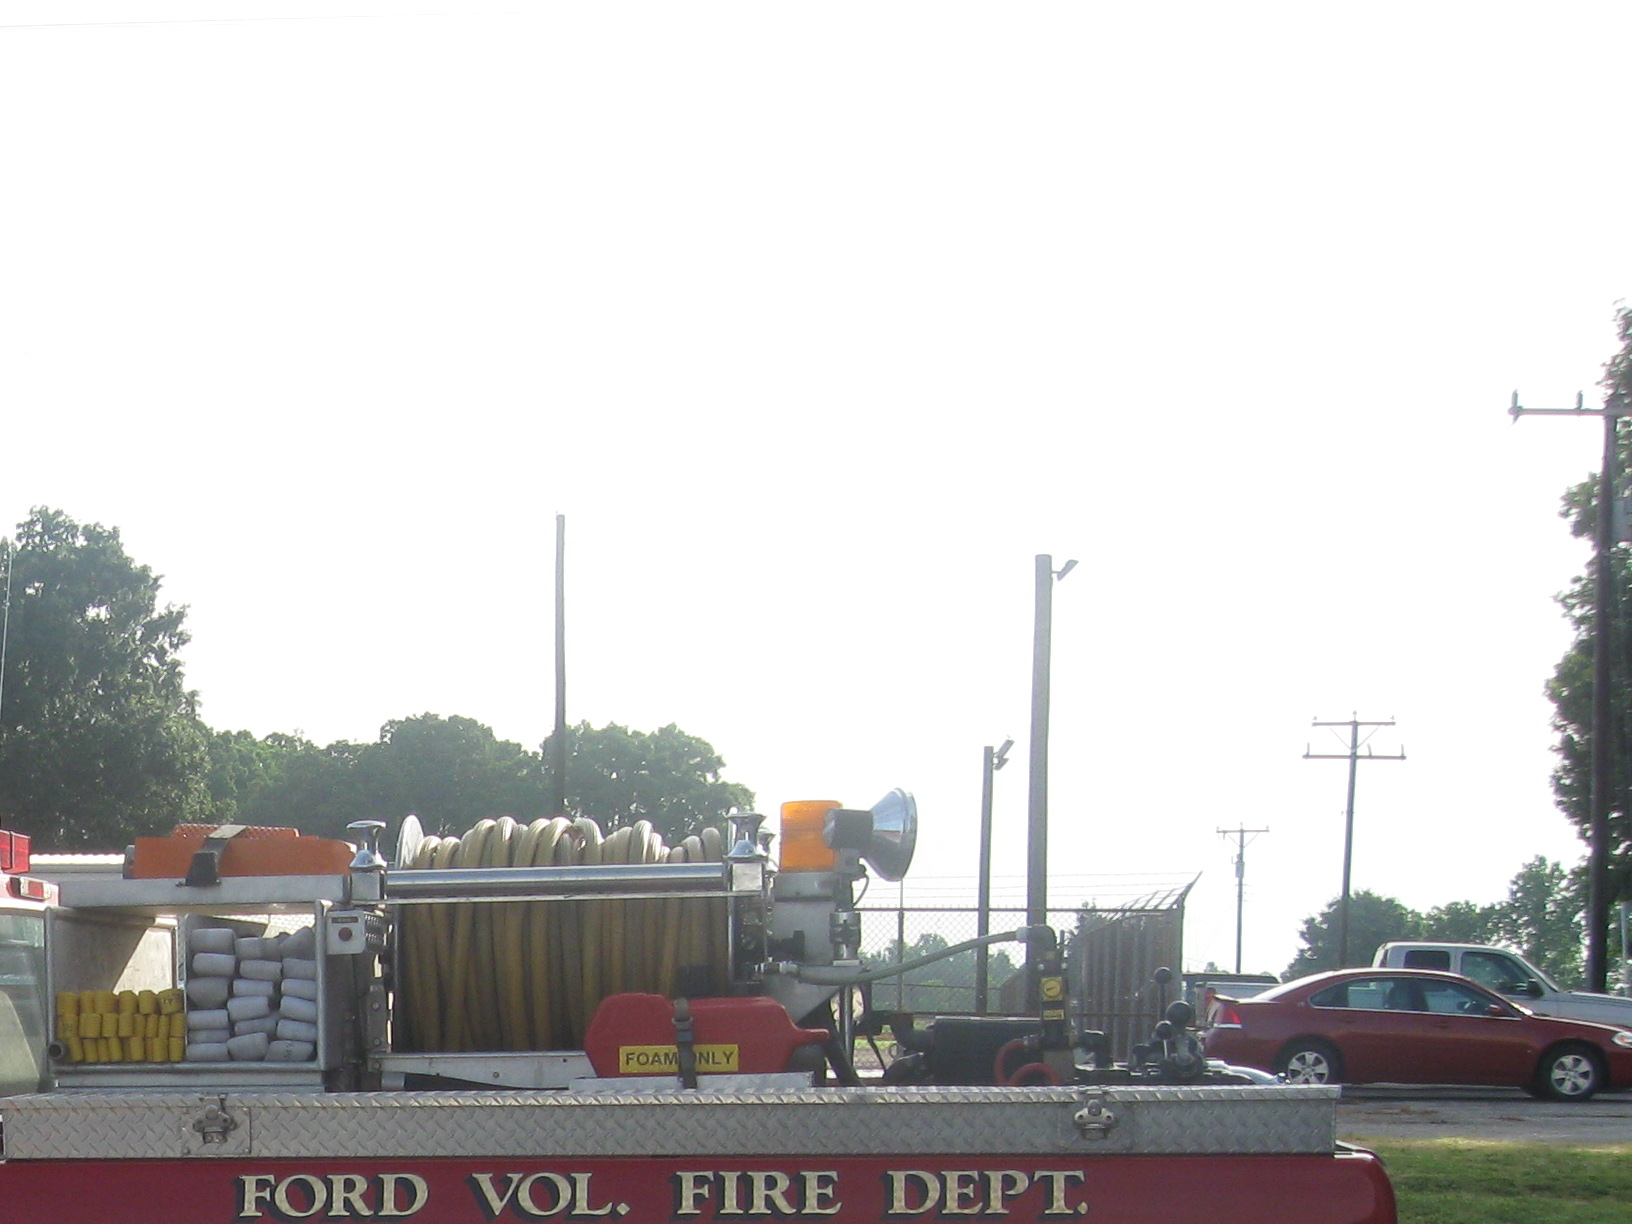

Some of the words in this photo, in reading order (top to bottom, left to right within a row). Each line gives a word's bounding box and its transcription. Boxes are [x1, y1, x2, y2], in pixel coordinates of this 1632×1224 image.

[625, 1051, 679, 1066] FOAM
[236, 1172, 430, 1219] FORD
[470, 1171, 631, 1219] VOL.
[672, 1170, 842, 1217] FIRE
[885, 1168, 1090, 1217] DEPT.
